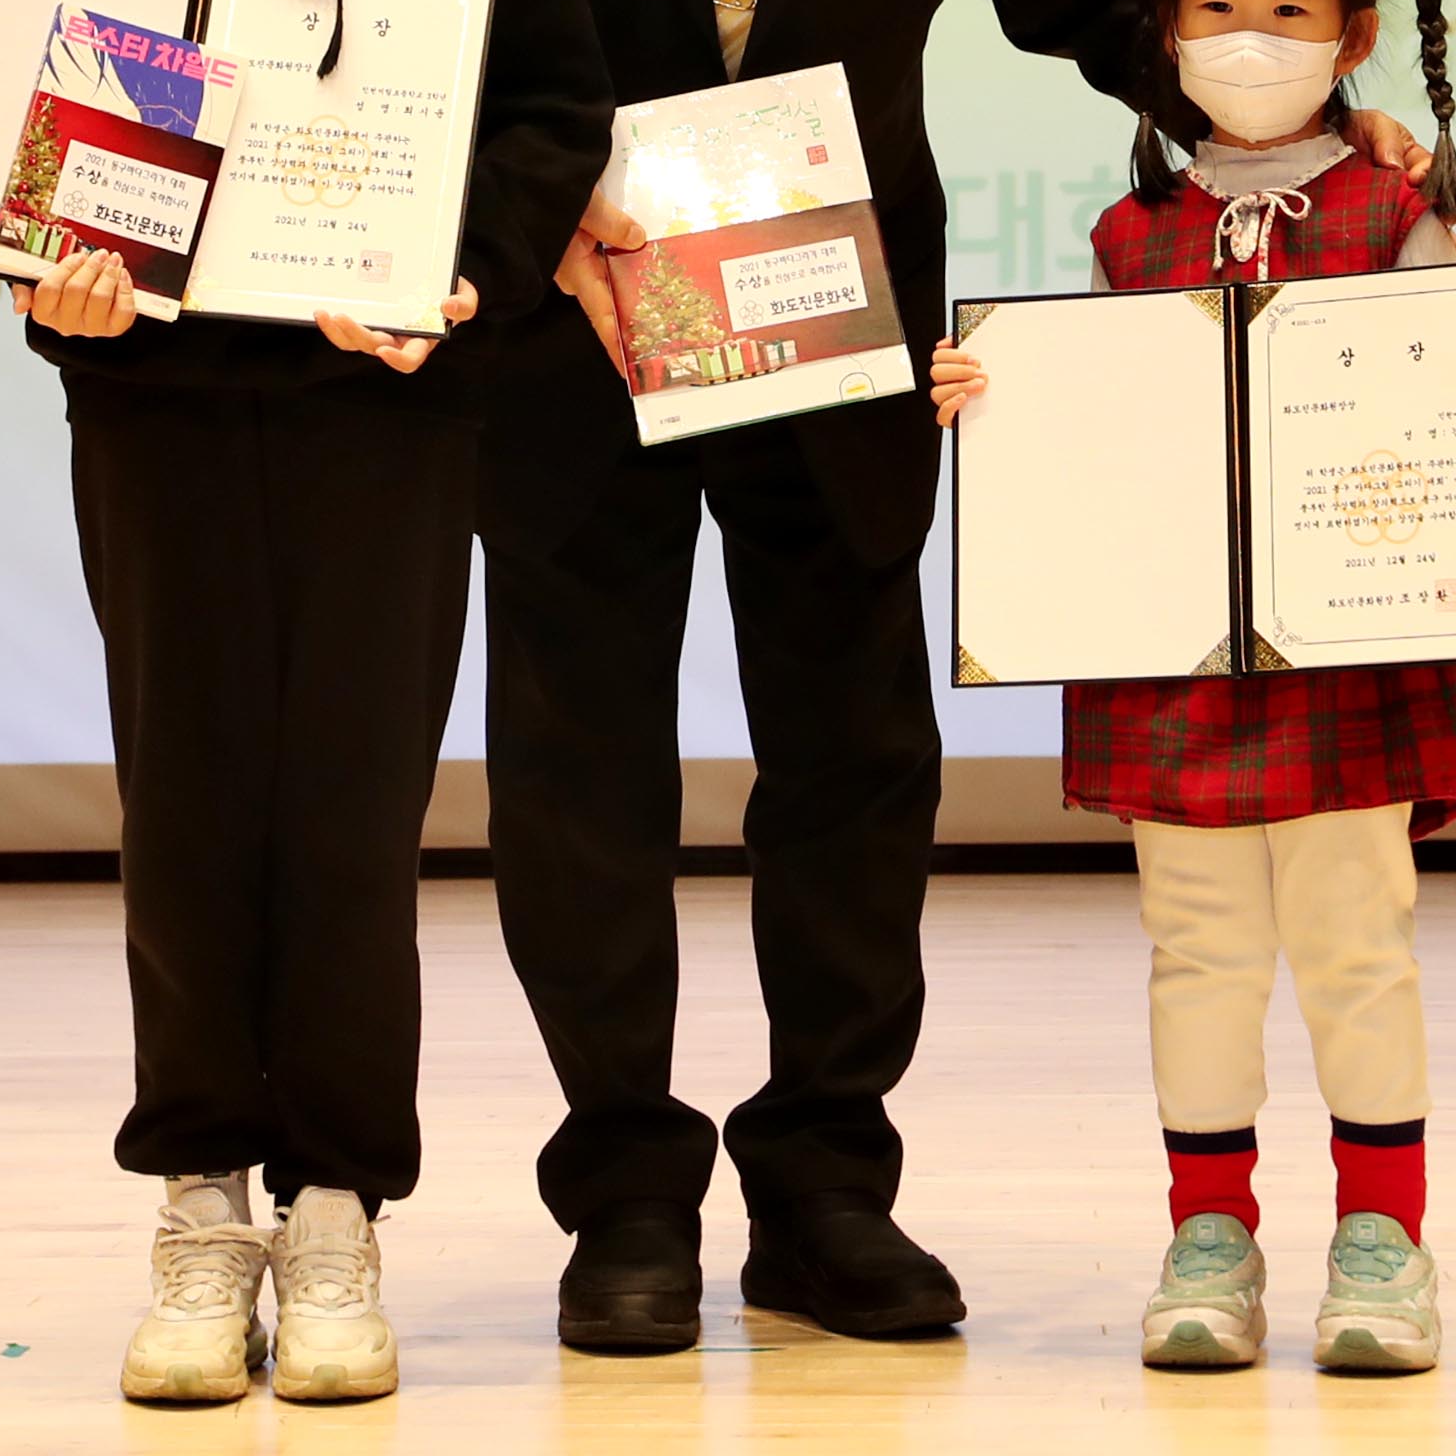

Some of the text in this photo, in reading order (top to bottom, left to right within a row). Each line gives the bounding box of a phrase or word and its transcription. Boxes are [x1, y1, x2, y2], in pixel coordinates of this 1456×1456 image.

[302, 12, 391, 37] 상 장
[64, 15, 238, 88] 몬스터 차일드
[296, 127, 368, 140] 화도진문화원에서
[339, 147, 365, 155] 그리기
[85, 153, 106, 166] 2021
[272, 158, 306, 168] 상상력과
[73, 165, 109, 187] 수상을
[94, 204, 183, 244] 화도진문화원
[274, 216, 368, 232] 2021년 12월 24일
[250, 251, 318, 266] 화도진문화원장
[739, 262, 759, 273] 2021
[735, 275, 770, 291] 수상을
[770, 286, 856, 315] 화도진문화원
[1338, 341, 1425, 367] 상 장
[1283, 400, 1356, 414] 화도진문화원장상
[1351, 460, 1421, 474] 화도진문화원에서
[1395, 479, 1421, 488] 그리기
[1332, 501, 1366, 511] 상상력과
[1345, 553, 1436, 567] 2021년 12월 24일
[1328, 595, 1393, 608] 화도진문화원장
